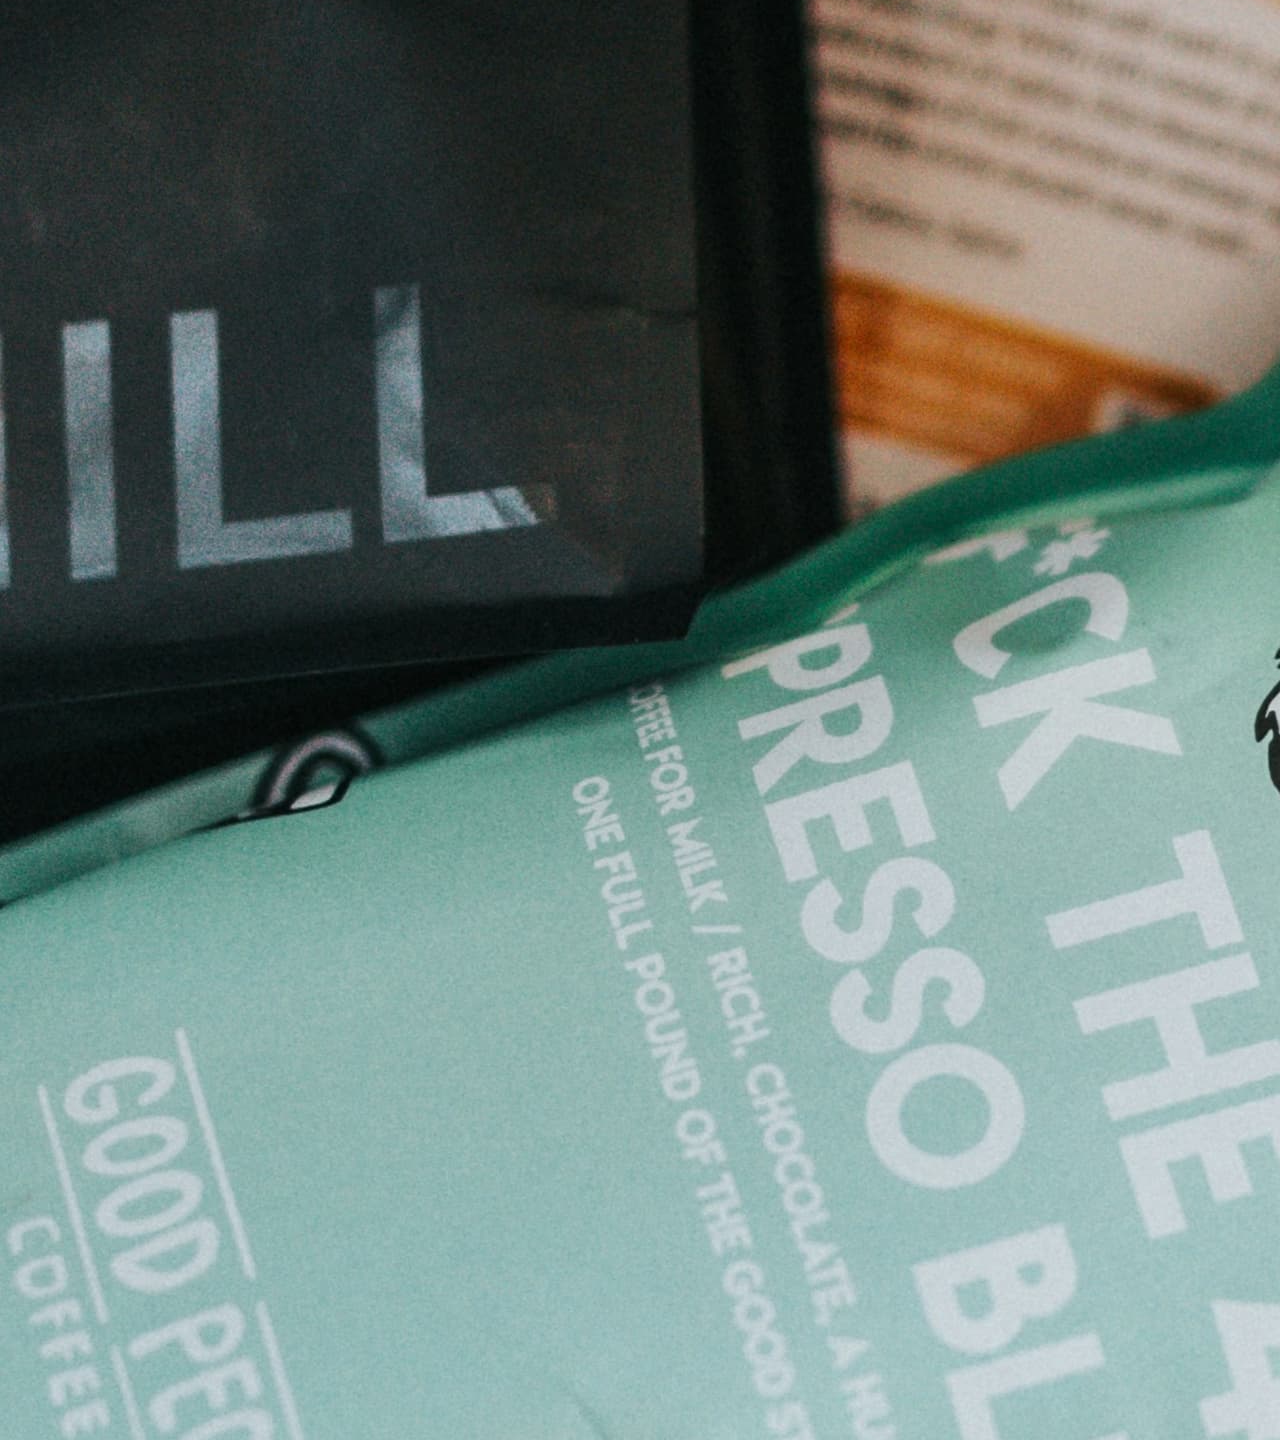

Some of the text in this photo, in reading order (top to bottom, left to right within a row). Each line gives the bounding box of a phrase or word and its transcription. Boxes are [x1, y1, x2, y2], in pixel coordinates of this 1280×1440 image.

[0, 282, 557, 590] ILL
[572, 775, 626, 852] ONE
[644, 745, 696, 817] FOR
[593, 850, 654, 952] FULL
[666, 816, 730, 914] MILK
[721, 603, 1025, 1190] PRESSO
[624, 952, 702, 1103] POUND
[62, 1054, 221, 1294] GOOD
[675, 1107, 718, 1167] OF
[745, 1063, 858, 1328] CHOCOLATE,
[696, 1170, 752, 1276] THE
[4, 1215, 113, 1440] COFFEE
[721, 1268, 794, 1399] GOOD
[827, 1334, 872, 1371] A
